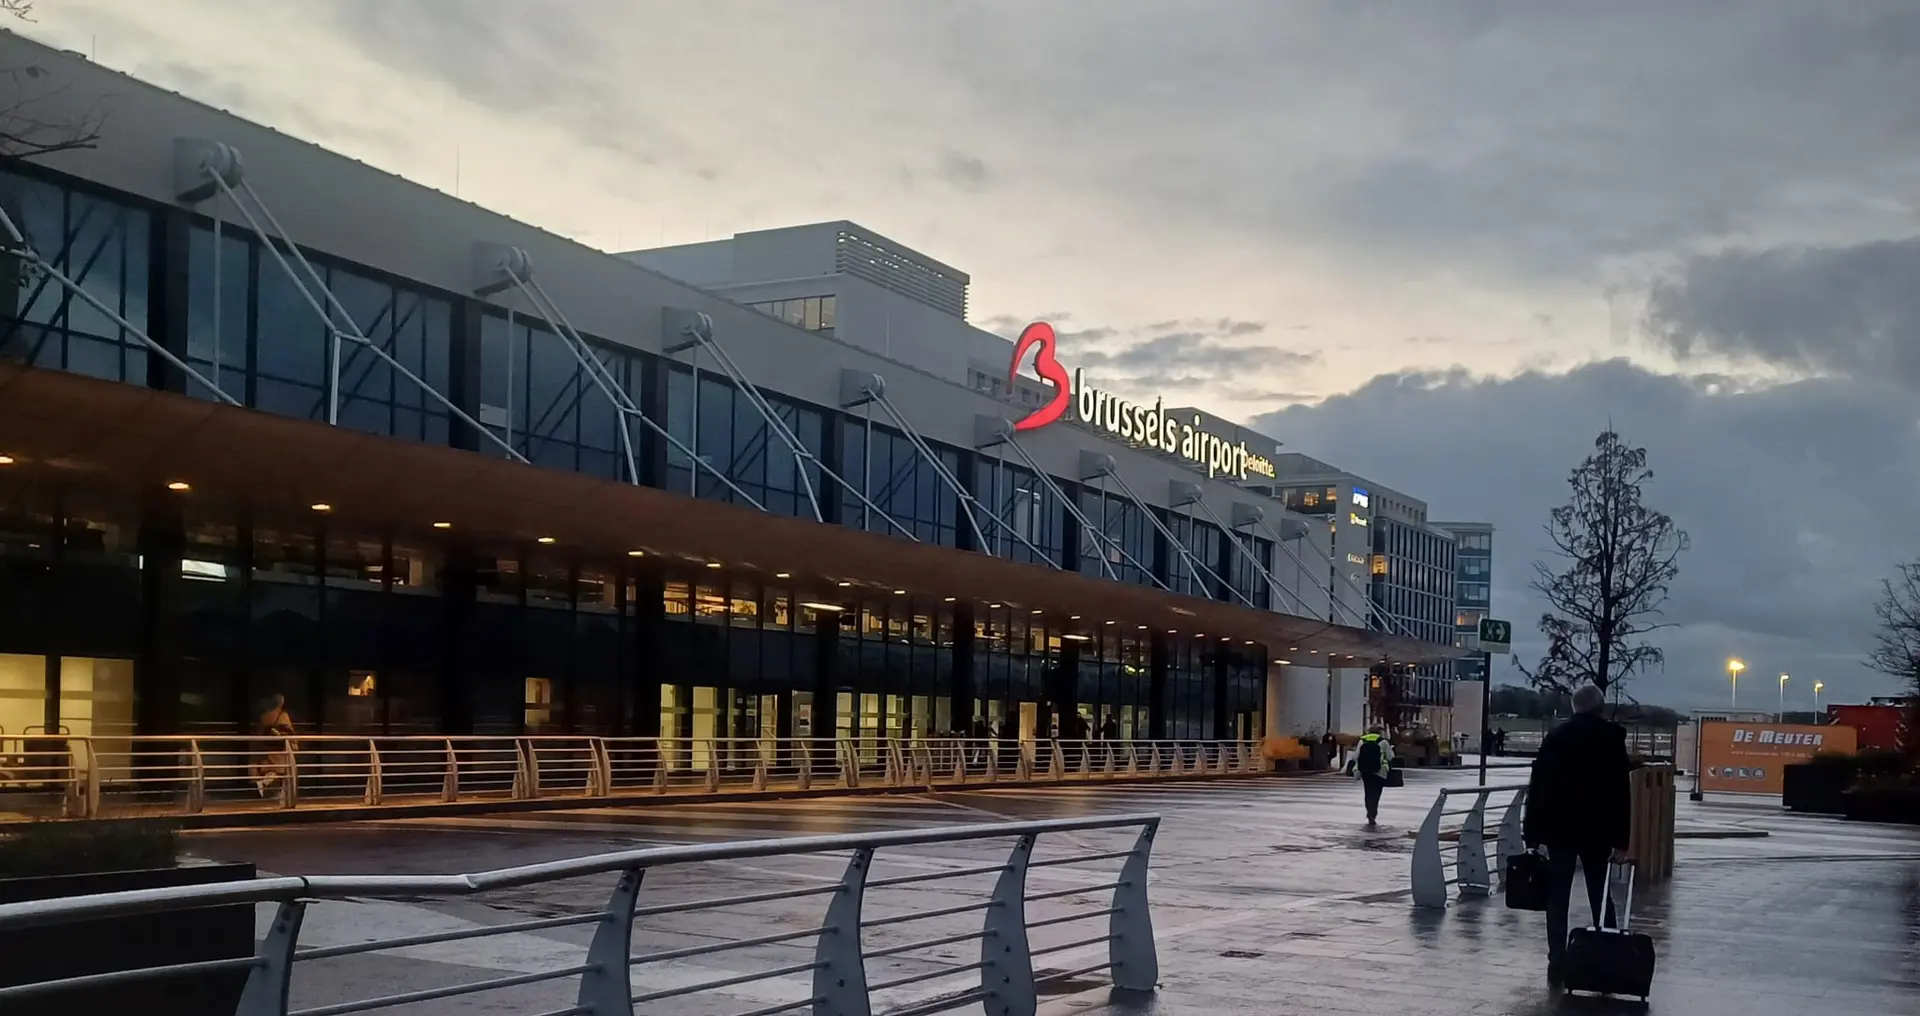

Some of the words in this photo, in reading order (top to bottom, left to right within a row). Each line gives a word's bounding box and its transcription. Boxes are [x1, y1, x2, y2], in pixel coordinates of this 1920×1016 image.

[1076, 367, 1177, 454] brussels
[1182, 414, 1248, 480] airport
[1732, 729, 1754, 743] DE
[1758, 730, 1824, 746] MEUTER
